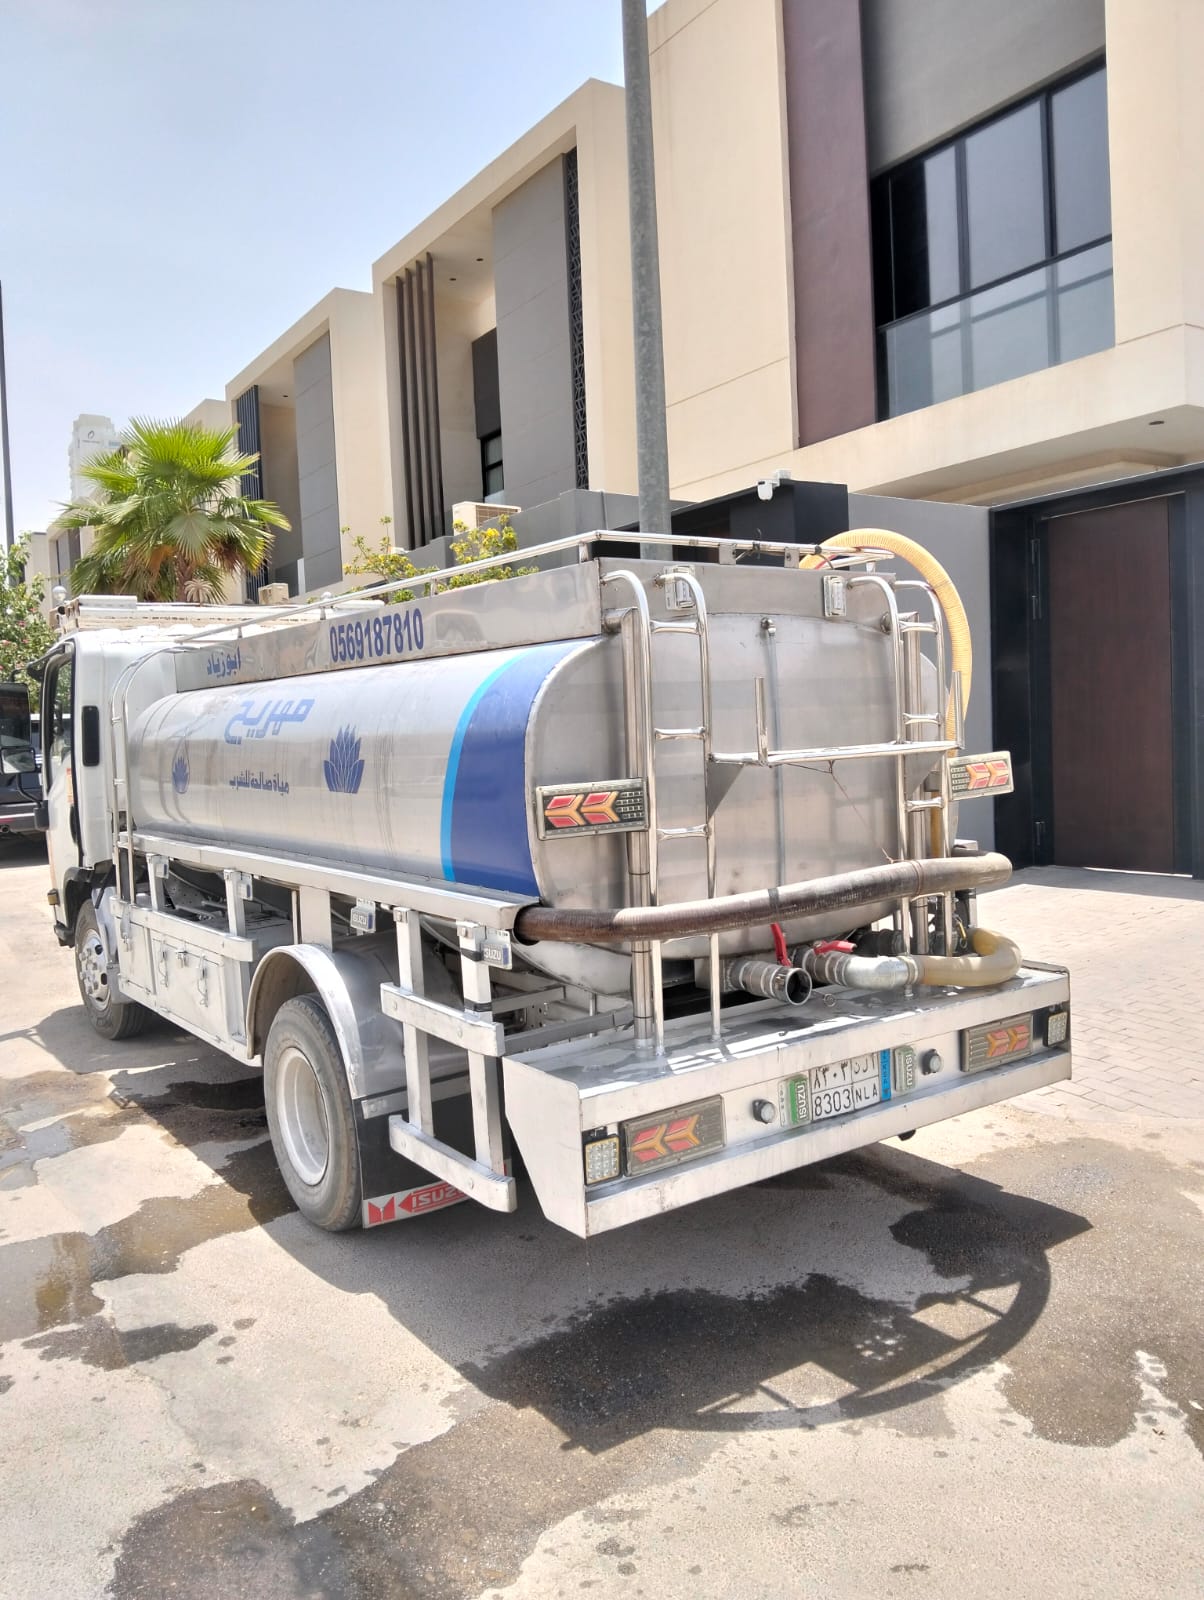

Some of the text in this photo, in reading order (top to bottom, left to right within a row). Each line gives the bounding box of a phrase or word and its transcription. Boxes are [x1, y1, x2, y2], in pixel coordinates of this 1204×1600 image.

[330, 608, 424, 662] 0569187810
[905, 1054, 913, 1086] ISUZU
[796, 1085, 807, 1119] ISUZU
[815, 1083, 878, 1117] 8303 NLA
[412, 1187, 462, 1208] ISUZ
